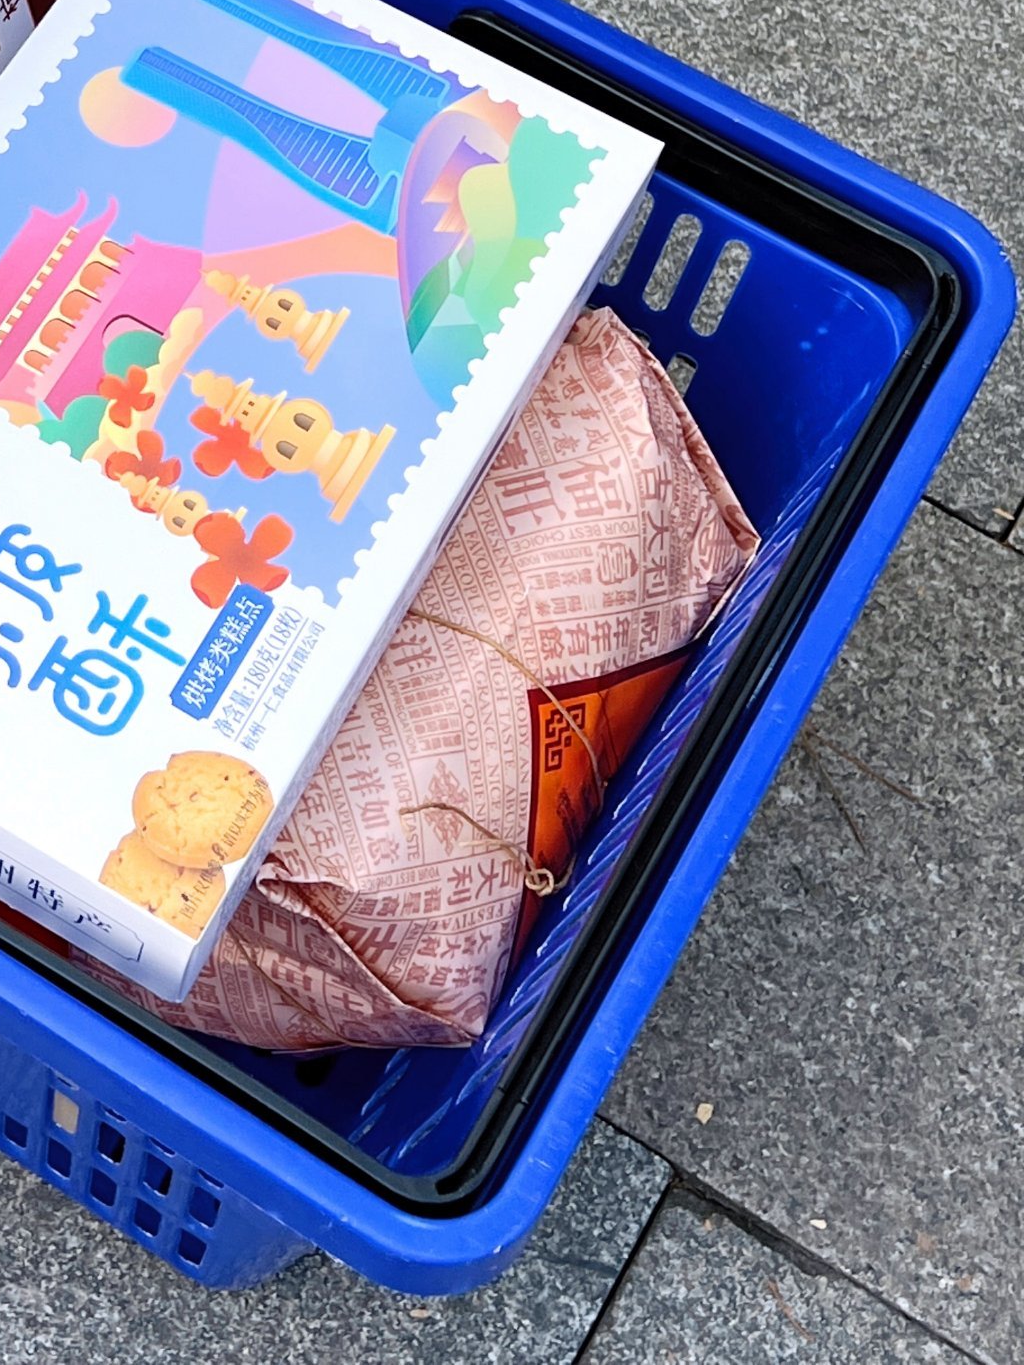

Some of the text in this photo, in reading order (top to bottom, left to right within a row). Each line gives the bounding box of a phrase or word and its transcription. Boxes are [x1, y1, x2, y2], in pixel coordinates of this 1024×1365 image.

[513, 520, 638, 552] YOUR BEST CHOICE
[27, 590, 189, 738] 酥
[181, 596, 265, 712] 烘烤类糕点
[337, 735, 401, 867] 吉祥如意
